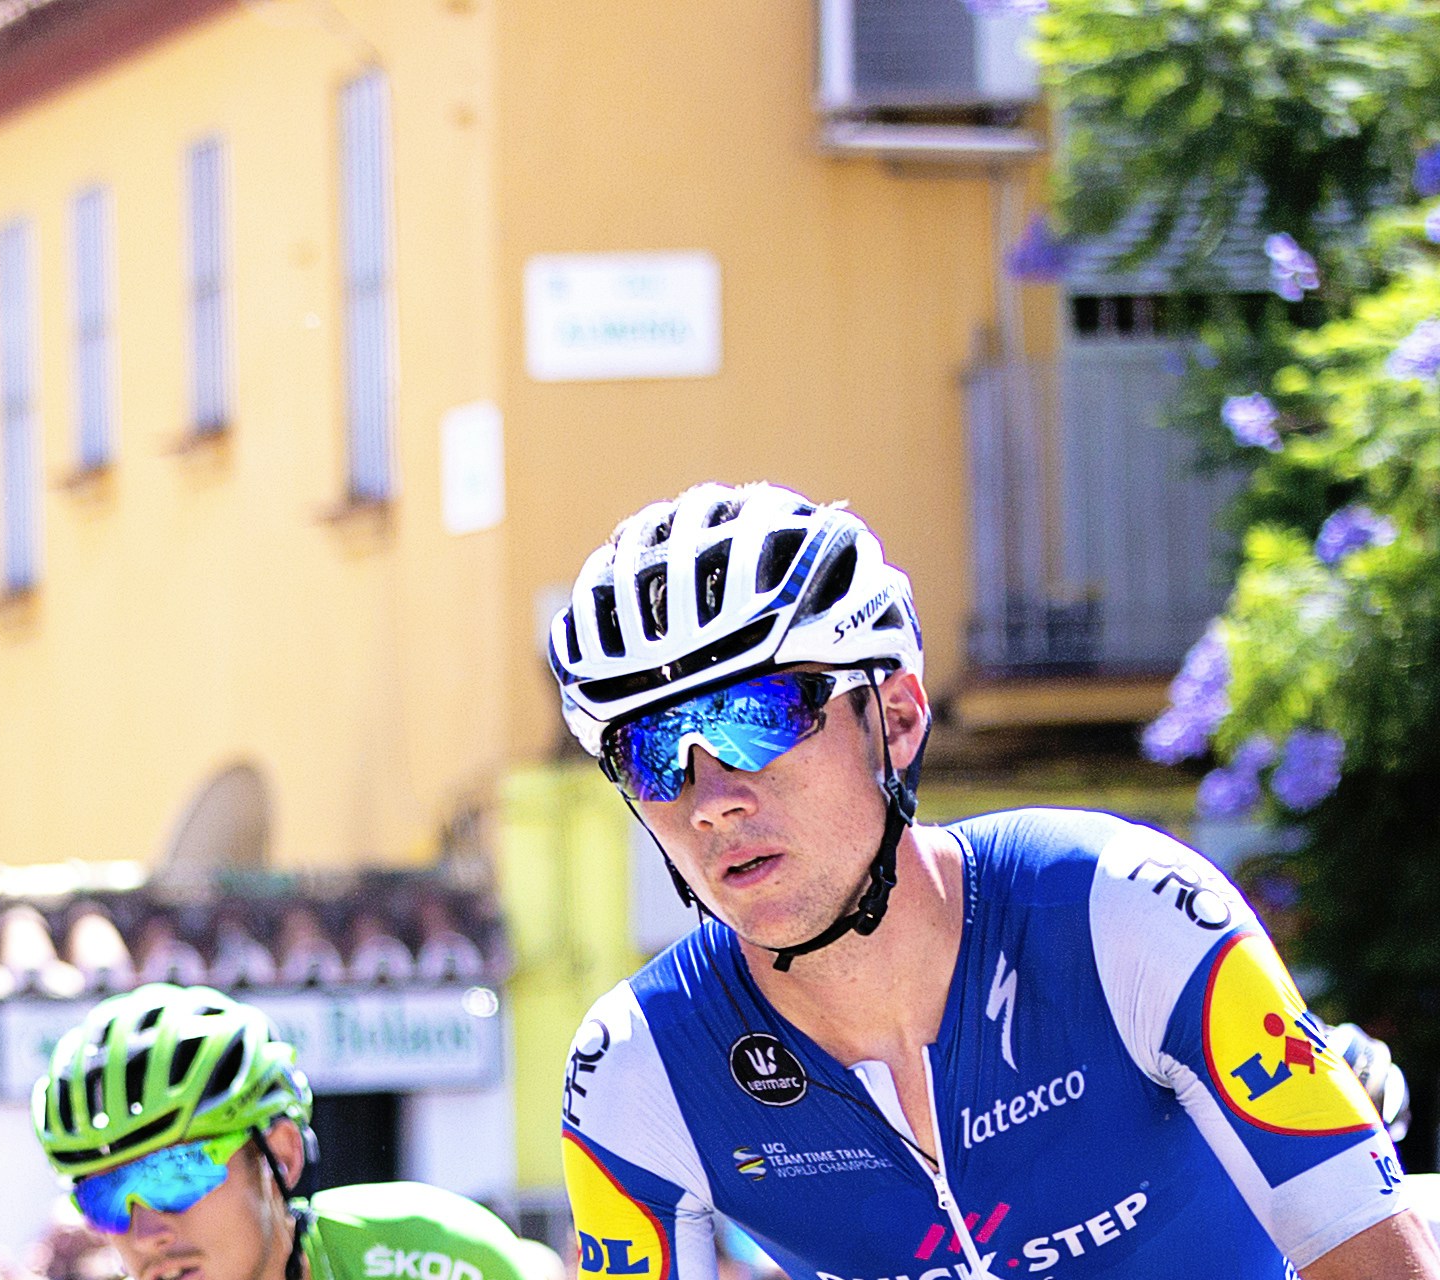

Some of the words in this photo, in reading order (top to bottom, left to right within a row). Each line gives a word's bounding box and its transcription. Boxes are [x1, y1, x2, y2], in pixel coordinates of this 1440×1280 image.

[747, 1073, 801, 1093] vermarc
[961, 1066, 1086, 1150] latexco
[762, 1142, 787, 1154] UCI
[767, 1153, 805, 1167] TEAM
[805, 1151, 837, 1163] TIME
[838, 1148, 876, 1161] TRIAL
[774, 1164, 818, 1178] WORLD
[579, 1232, 649, 1275] DL
